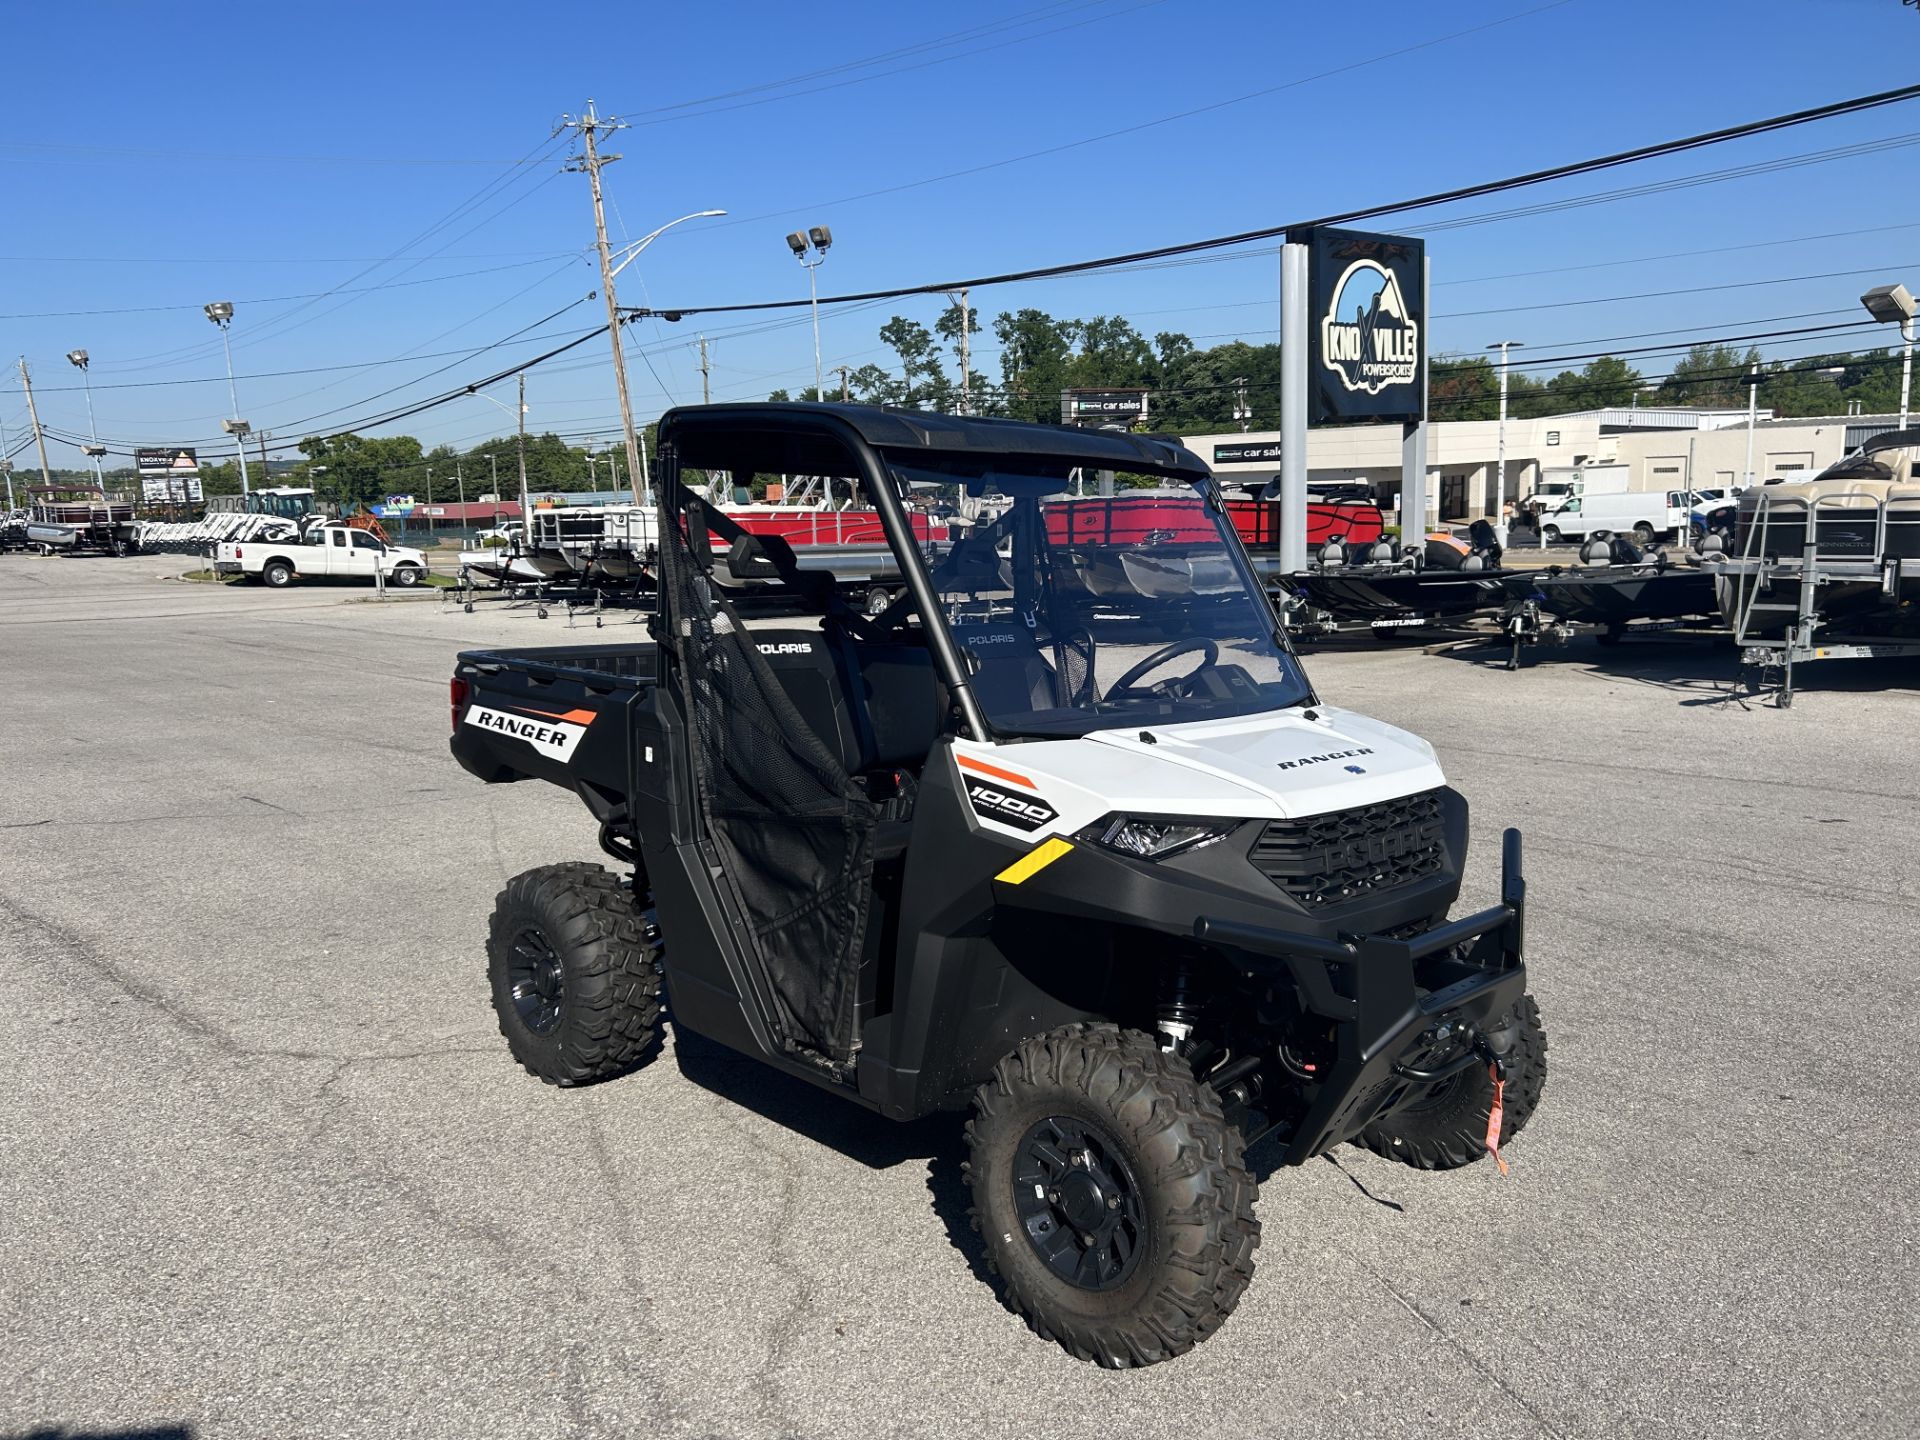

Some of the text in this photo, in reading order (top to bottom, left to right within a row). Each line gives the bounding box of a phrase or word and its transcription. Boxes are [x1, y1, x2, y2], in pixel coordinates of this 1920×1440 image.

[1329, 324, 1413, 362] KNOXVILLE
[1362, 363, 1413, 377] POWERSPORTS
[1103, 402, 1117, 410] car
[1119, 400, 1140, 410] sales
[1243, 449, 1261, 457] car
[1371, 618, 1426, 628] CRESTLINER
[1627, 622, 1685, 632] CRESTLINER
[968, 634, 1015, 646] POLARIS
[755, 643, 812, 654] OLARIS
[478, 711, 567, 747] RANGER
[1277, 748, 1375, 770] RANGER
[970, 786, 1052, 820] 1000
[1325, 824, 1442, 875] POLARIS
